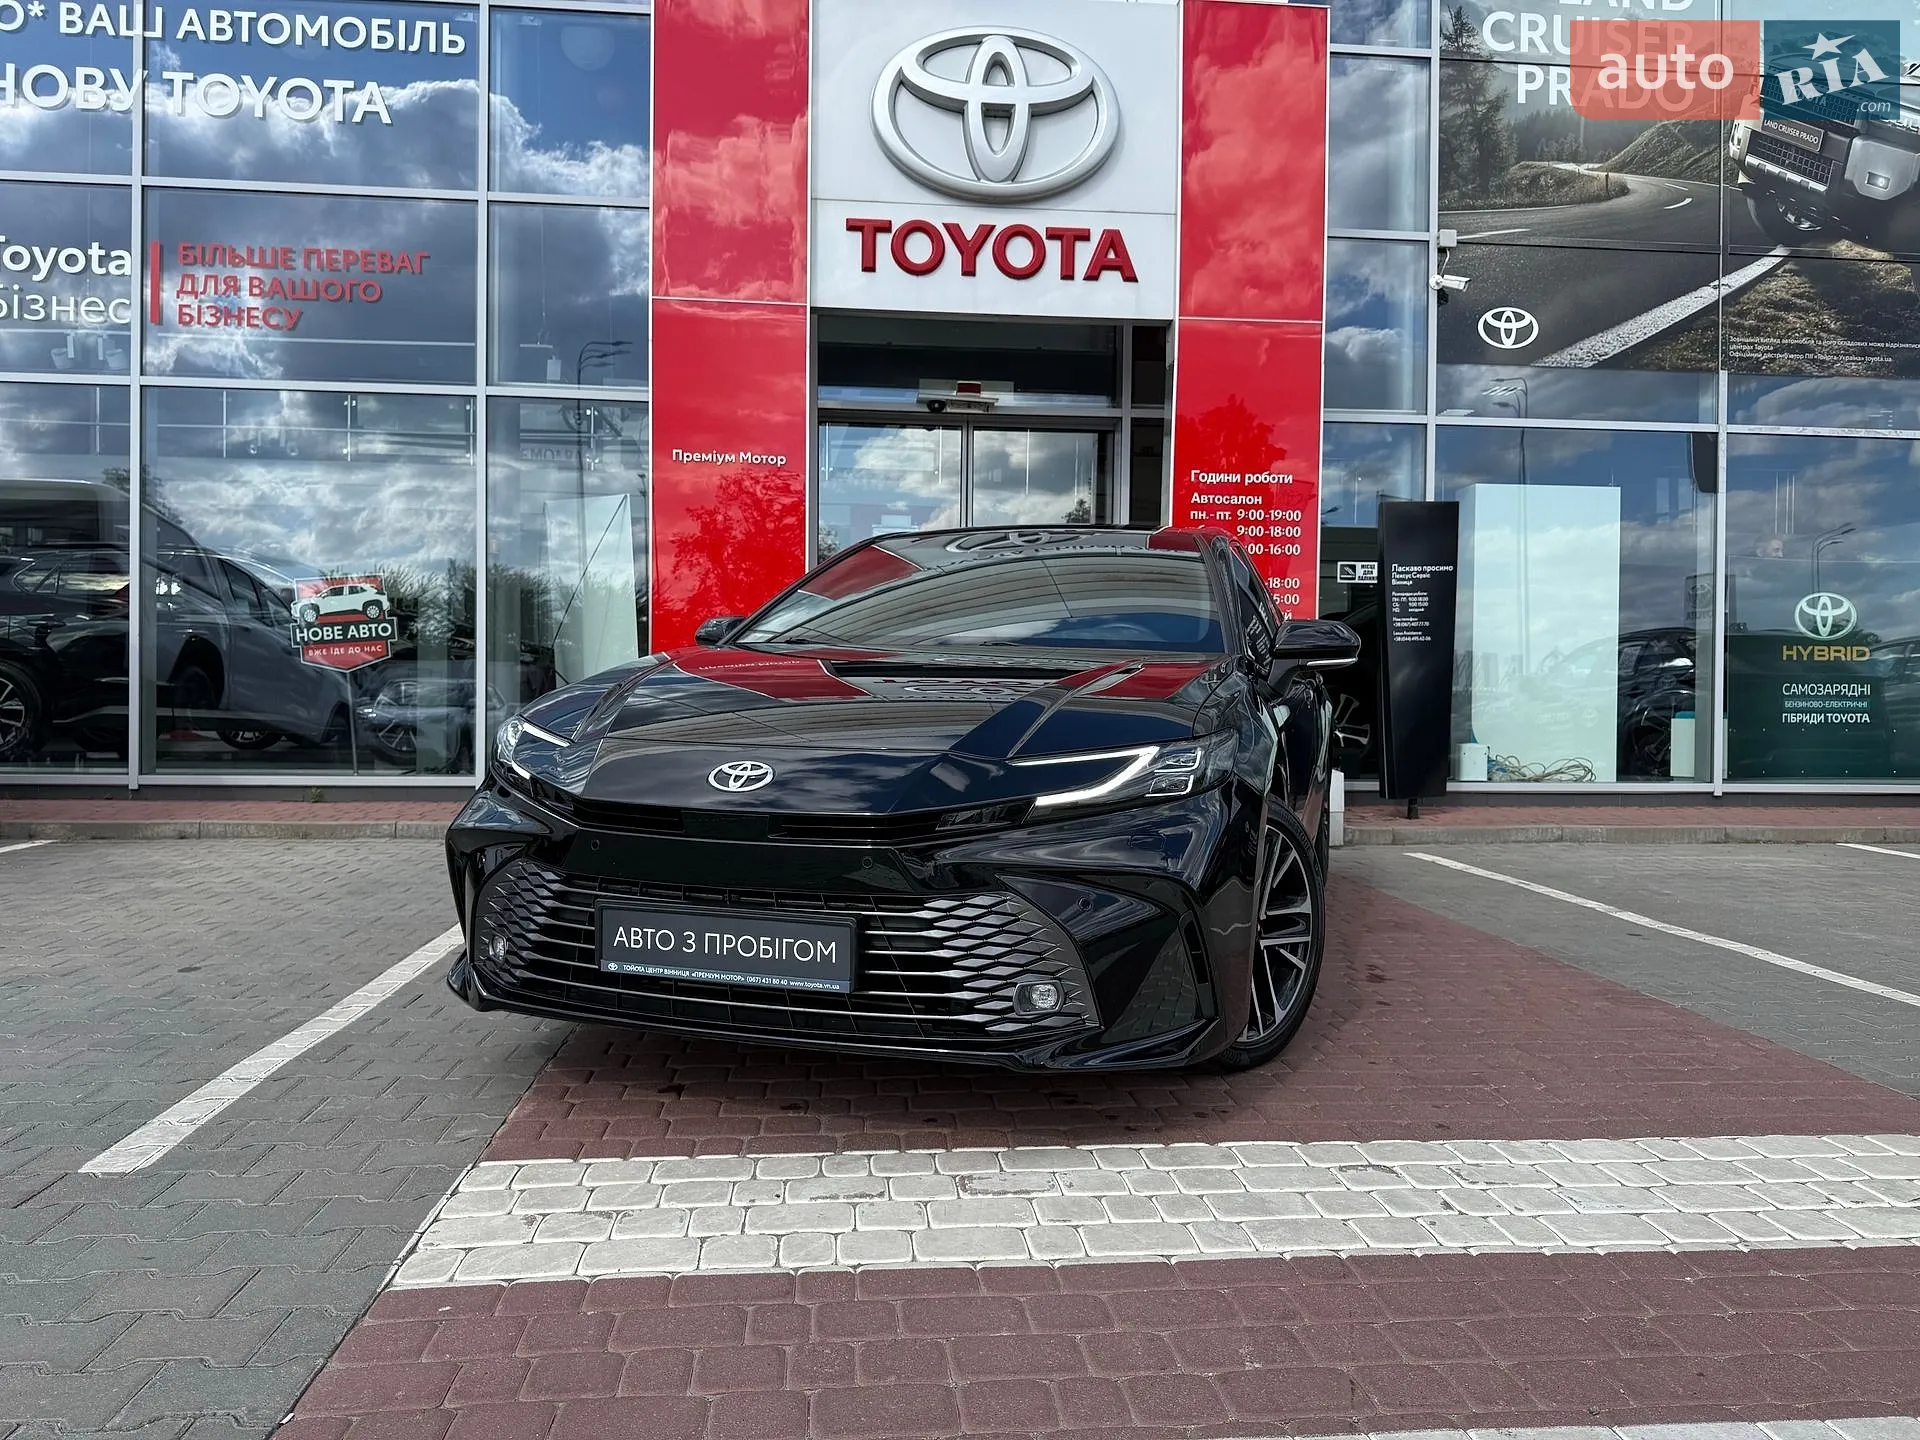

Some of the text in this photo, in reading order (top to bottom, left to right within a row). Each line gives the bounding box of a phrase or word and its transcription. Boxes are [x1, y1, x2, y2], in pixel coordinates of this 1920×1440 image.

[59, 2, 163, 38] ВАШ
[176, 8, 466, 55] АВТОМОБІЛЬ
[1482, 11, 1697, 59] CRUISER
[162, 71, 393, 125] TOYOTA
[1517, 64, 1694, 112] PRADO
[1764, 119, 1819, 144] LAND CRUISER PRADO
[0, 235, 132, 282] oyota
[178, 242, 431, 274] БІЛЬШЕ ПЕРЕВАГ
[846, 218, 1139, 283] TOYOTA
[176, 273, 383, 302] ДЛЯ ВАШОГО
[177, 304, 303, 330] БІЗНЕСУ
[672, 448, 788, 468] Преміум Мотор
[1190, 469, 1293, 486] Години роботи
[1190, 491, 1263, 505] Автосалон
[1236, 508, 1302, 521] 9:00-19:00
[1236, 524, 1302, 538] 9:00-18:00
[296, 622, 393, 642] НОВЕ АВТО
[308, 648, 328, 657] ВЖЕ
[348, 647, 361, 655] ДО
[1782, 645, 1871, 661] HYBRID
[1782, 683, 1871, 698] САМОЗАРЯДНІ
[1784, 700, 1868, 709] БЕНЗИНОВО-ЕЛЕКТРИЧНІ
[1782, 713, 1871, 725] ГІБРИДИ TOYOTA
[613, 926, 836, 964] АВТО З ПРОБІГОМ
[623, 964, 645, 973] ТОЙОТА
[645, 966, 664, 976] ЦЕНТР
[664, 968, 690, 978] ВІННИЦЯ
[746, 975, 762, 984] (067)
[762, 976, 772, 985] 431
[780, 978, 788, 986] 40
